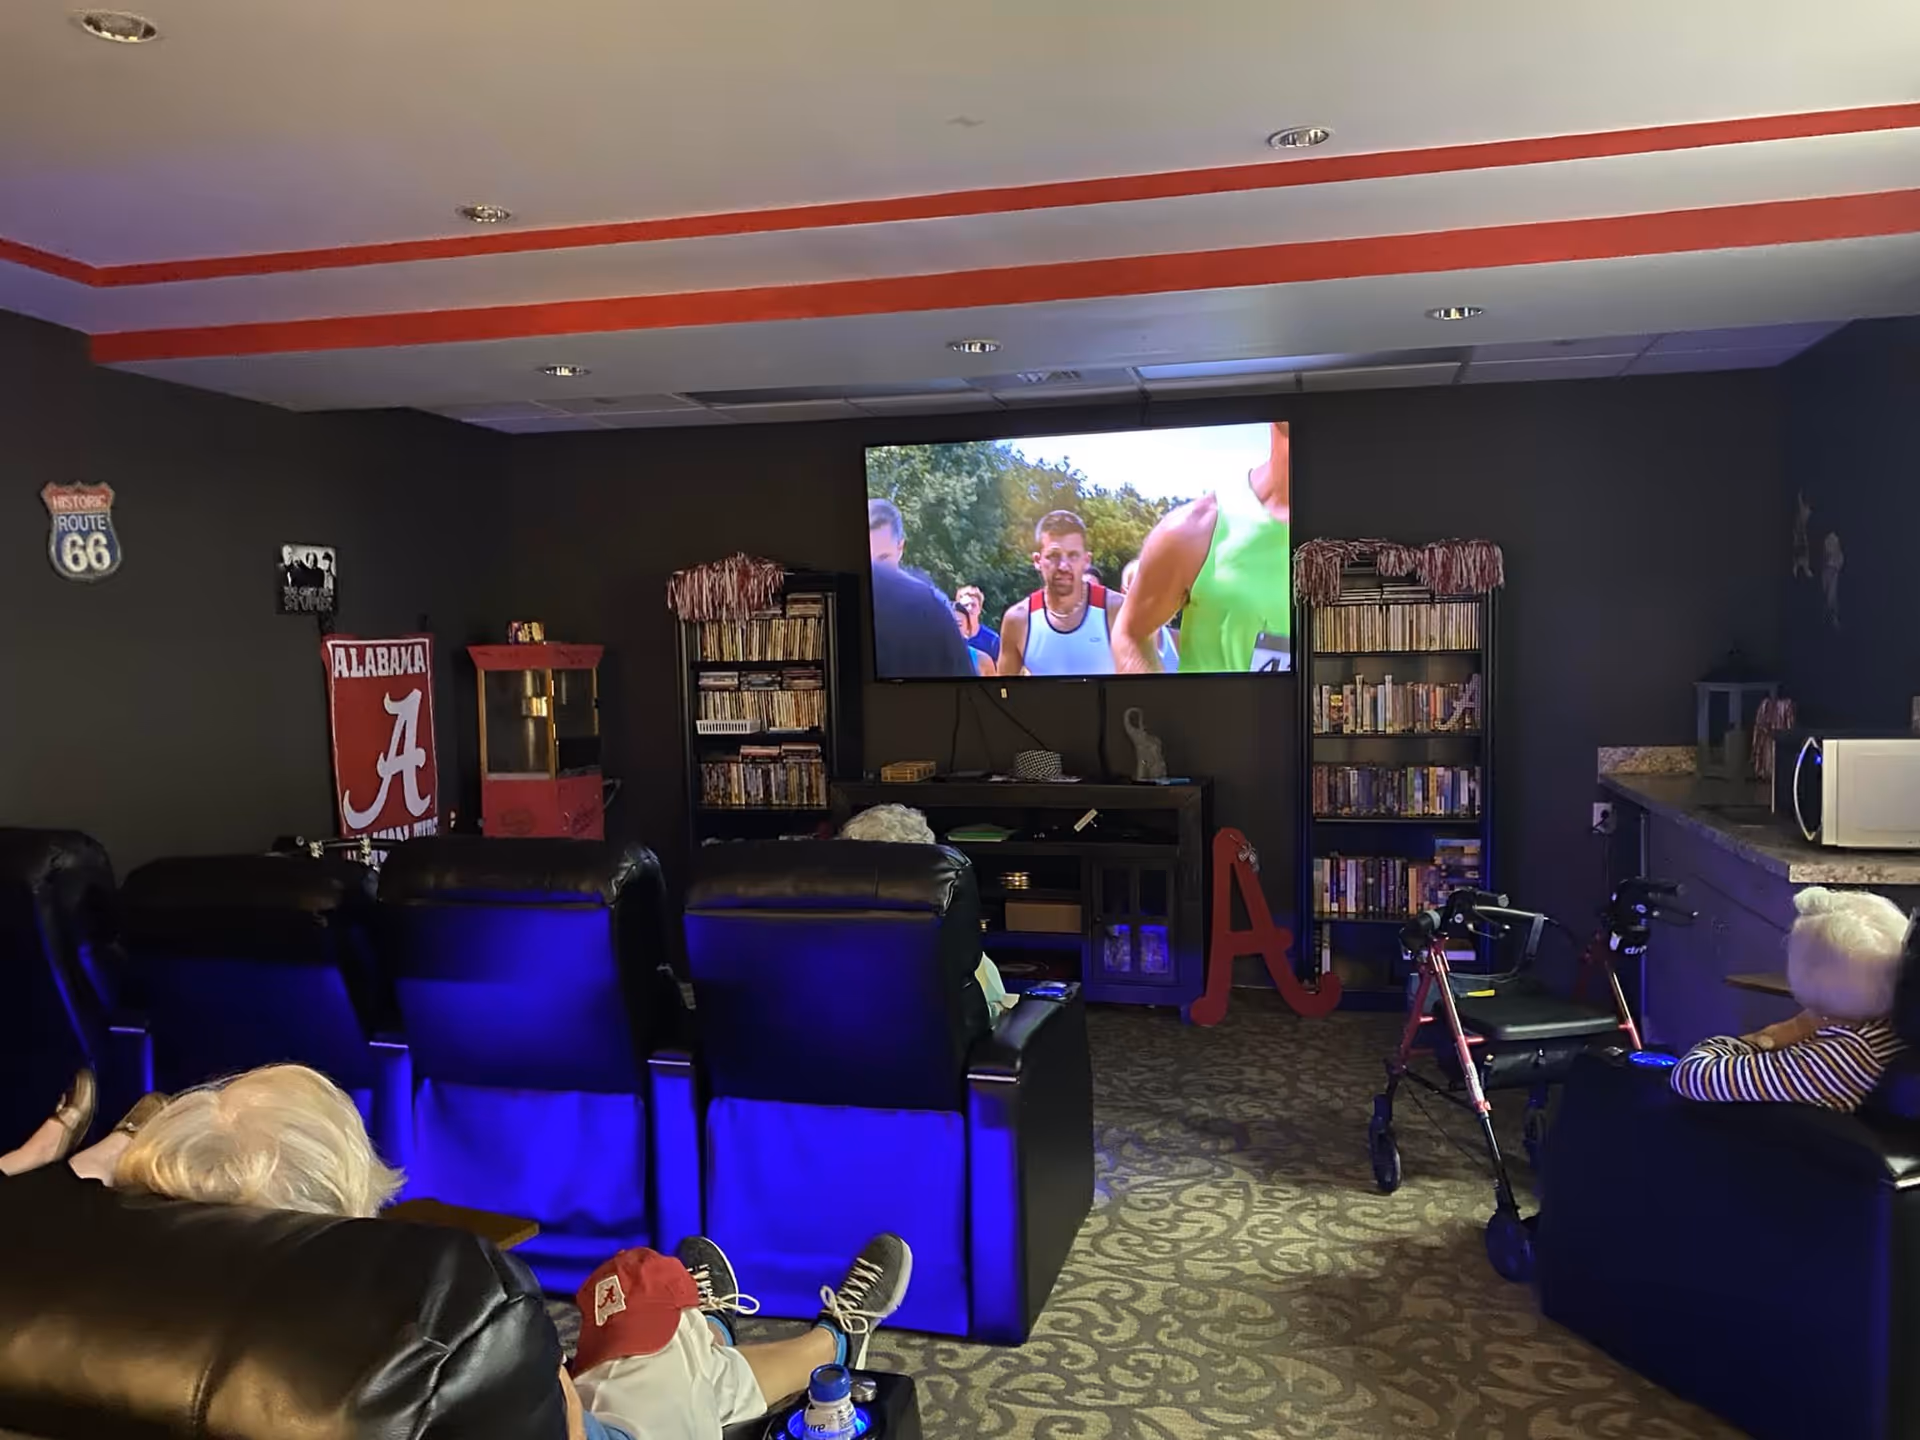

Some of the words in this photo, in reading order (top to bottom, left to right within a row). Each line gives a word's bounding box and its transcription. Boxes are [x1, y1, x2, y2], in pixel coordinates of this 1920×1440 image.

[52, 494, 108, 510] HISTORIC
[57, 514, 107, 532] ROUTE
[62, 531, 111, 572] 66
[334, 644, 427, 678] ALABAMA
[343, 688, 431, 829] A
[1190, 827, 1342, 1026] A
